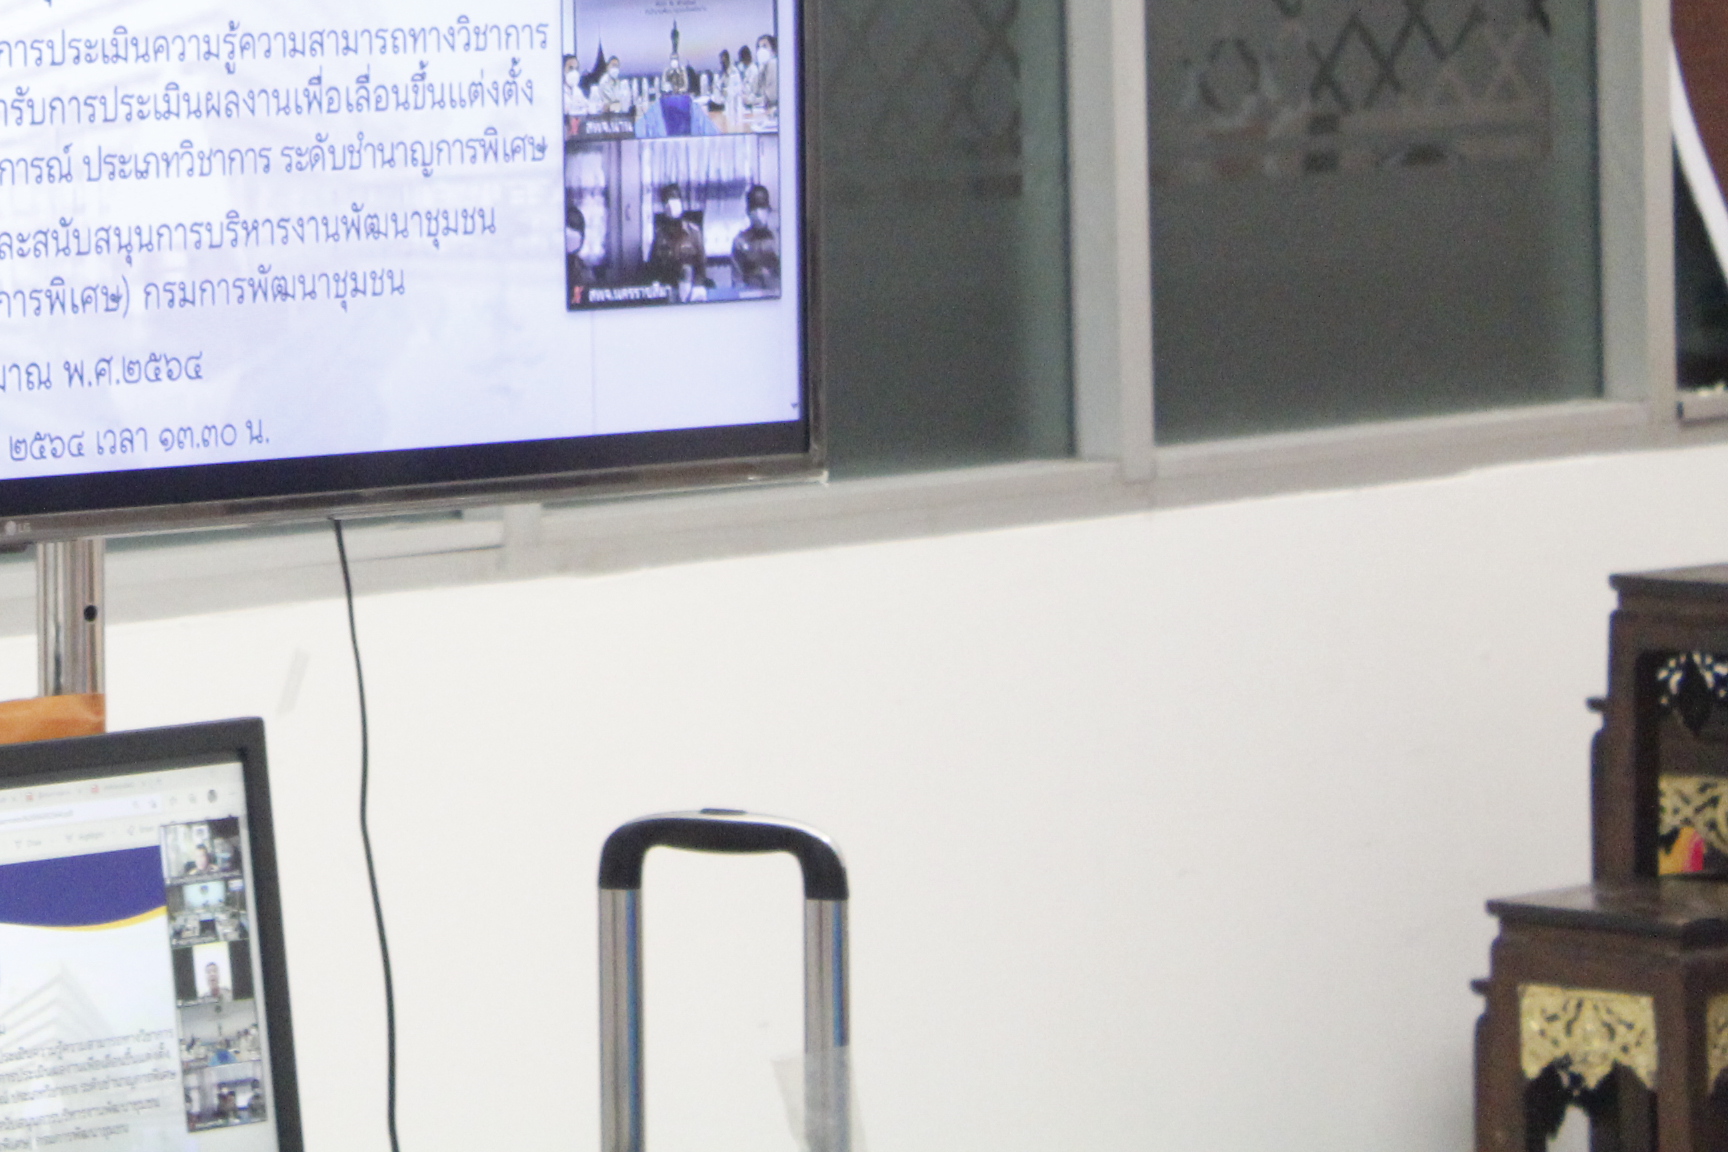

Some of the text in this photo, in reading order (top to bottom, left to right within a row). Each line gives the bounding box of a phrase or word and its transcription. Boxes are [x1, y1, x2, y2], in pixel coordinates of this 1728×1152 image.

[83, 139, 272, 183] ประเภทวิชาการ
[280, 126, 548, 178] ระดับชำนาญการพิเศษ
[143, 264, 406, 313] กรมการพัฒนาชุมชน
[64, 351, 204, 390] พ.ศ.๒๕๖๔
[9, 430, 85, 463] ๒๕๖๔
[96, 425, 148, 456] เวลา
[158, 422, 237, 452] ๑๓.๓๐
[246, 417, 270, 446] น.
